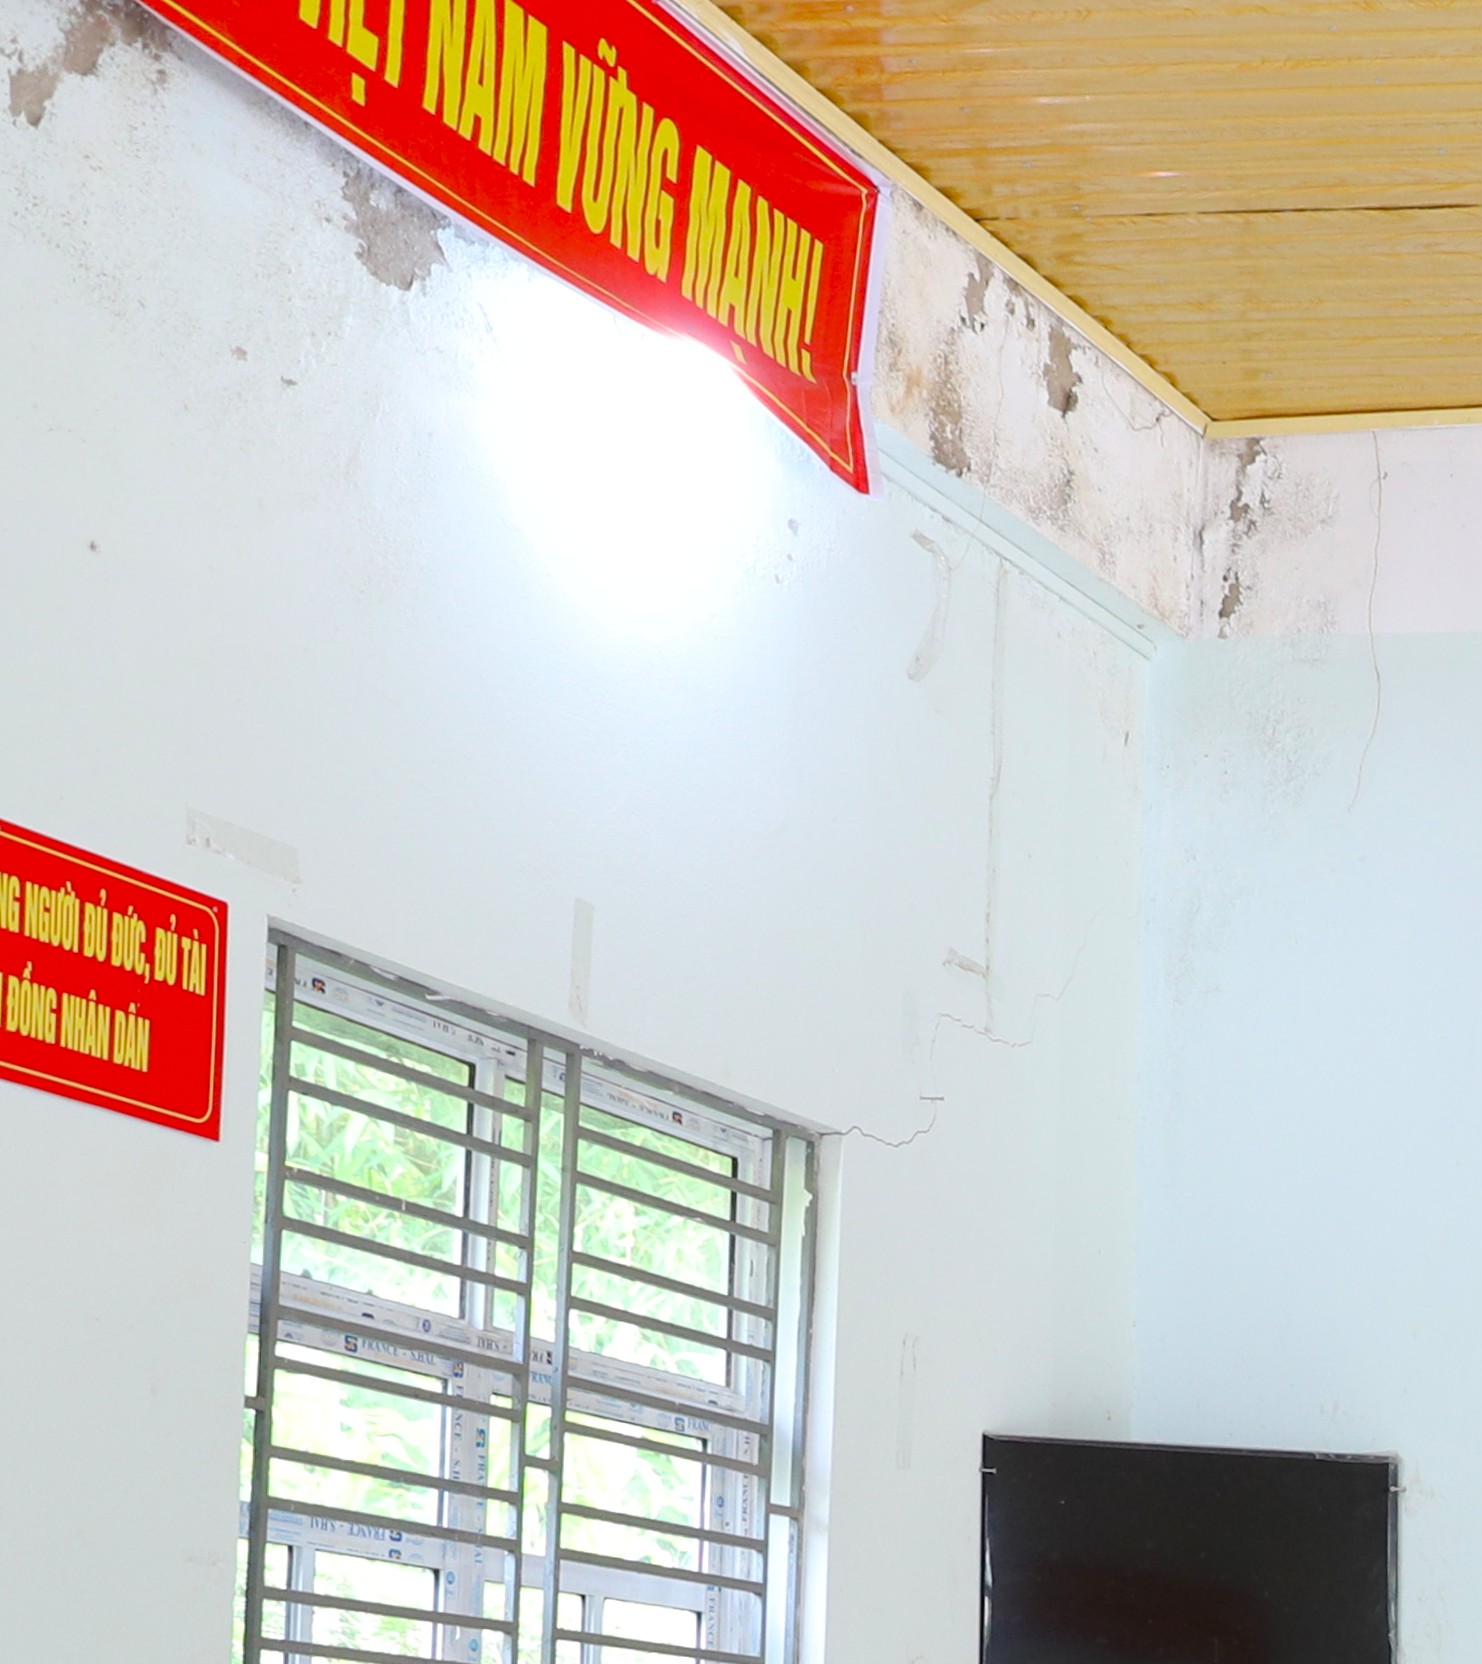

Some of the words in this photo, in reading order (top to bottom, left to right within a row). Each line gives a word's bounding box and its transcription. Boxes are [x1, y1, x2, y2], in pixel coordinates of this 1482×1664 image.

[422, 0, 547, 187] NAM
[555, 39, 682, 283] VỮNG
[680, 144, 824, 384] MẠNH!
[24, 882, 80, 951] NGƯỜI
[83, 890, 108, 961] ĐỦ
[111, 905, 151, 984] ĐỨC,
[154, 915, 177, 984] ĐỦ
[181, 930, 206, 994] TÀI
[6, 963, 57, 1043] ĐỒNG
[60, 991, 110, 1059] NHÂN
[113, 1004, 150, 1071] DÂN
